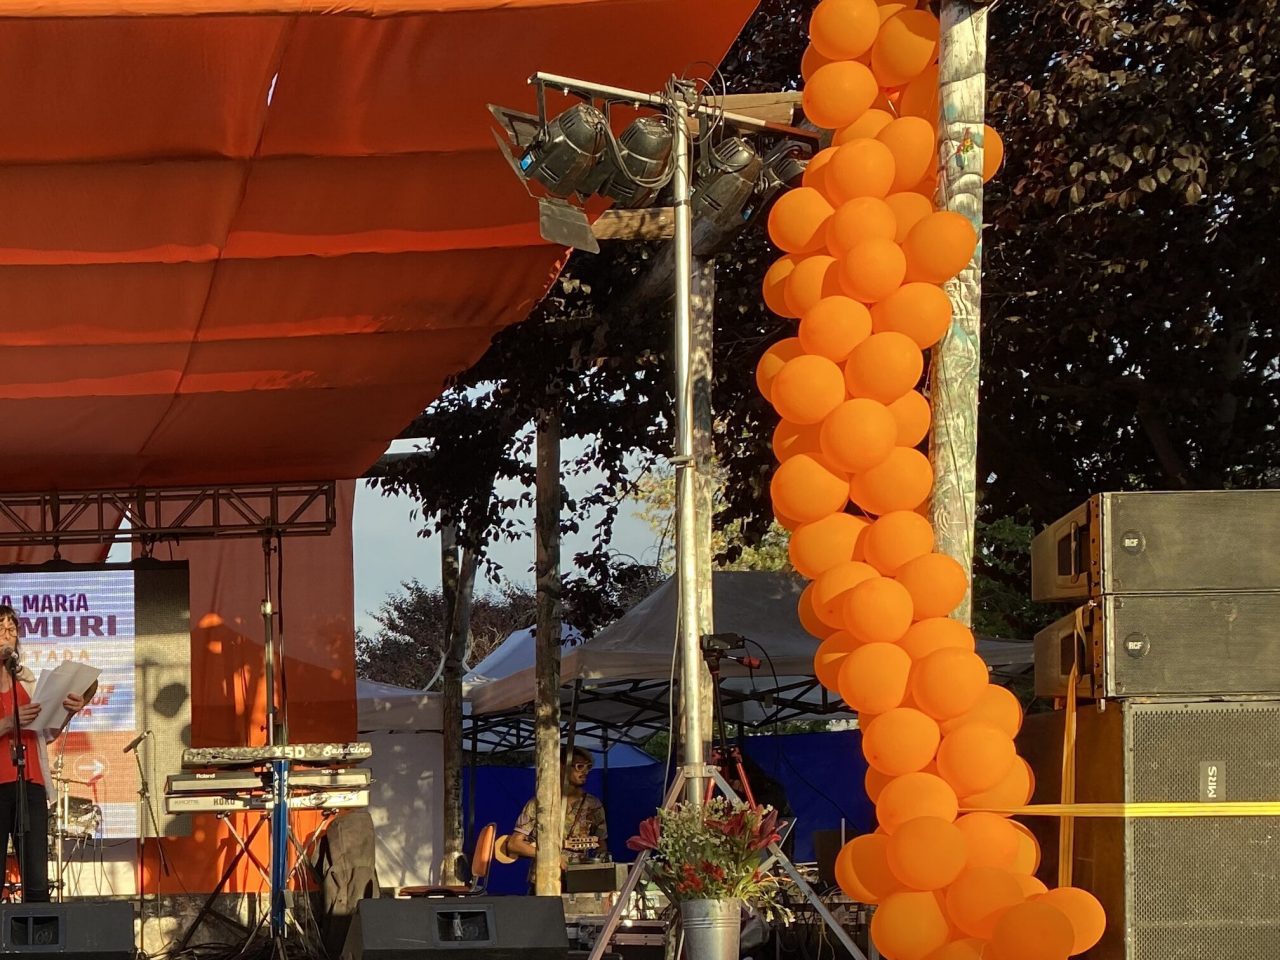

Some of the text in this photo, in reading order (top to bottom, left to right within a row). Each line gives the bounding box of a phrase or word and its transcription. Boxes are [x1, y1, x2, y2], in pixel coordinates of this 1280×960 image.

[1124, 539, 1139, 547] RCF
[1128, 642, 1142, 650] RCF
[274, 744, 371, 759] X5D Sandrino
[1207, 766, 1218, 798] MRS
